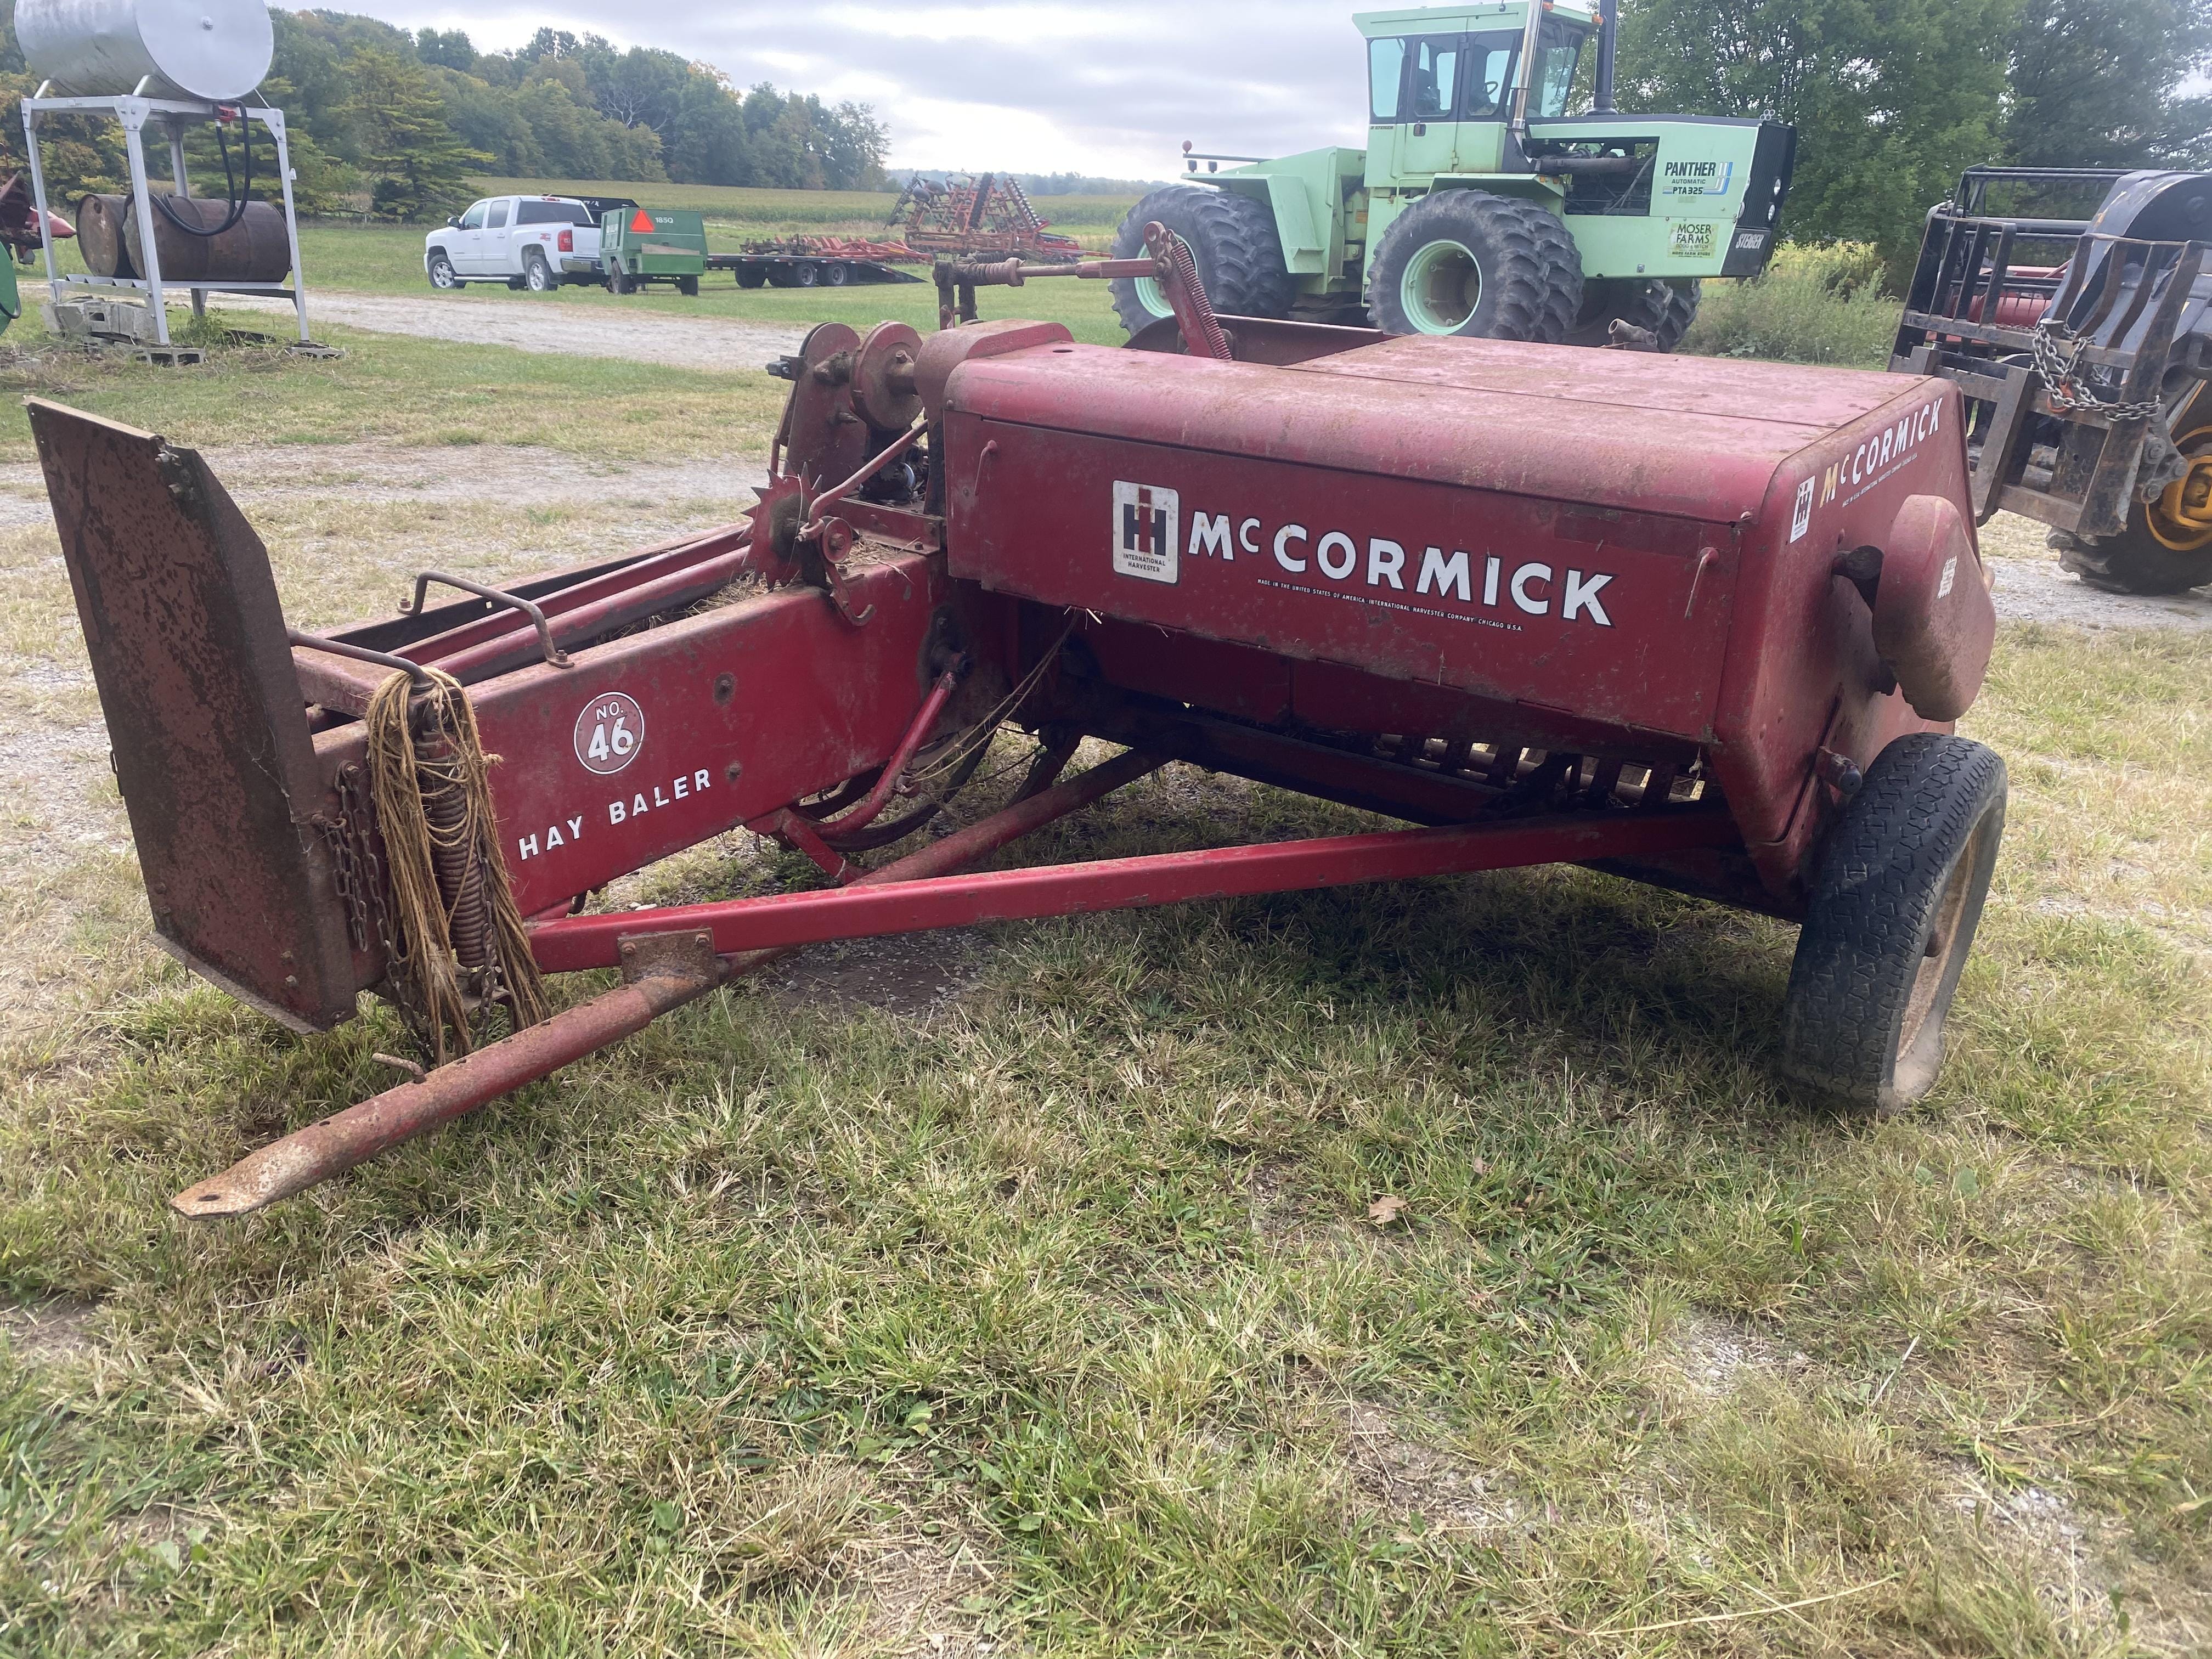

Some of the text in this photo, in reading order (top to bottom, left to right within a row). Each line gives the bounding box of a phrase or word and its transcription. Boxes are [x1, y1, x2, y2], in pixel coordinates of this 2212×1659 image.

[1664, 162, 1716, 176] PANTHER
[1677, 224, 1712, 234] MOSER
[1676, 234, 1710, 244] FARMS
[1123, 553, 1166, 566] INTERNATIONAL
[1128, 561, 1160, 573] HARVESTER
[1292, 585, 1311, 594] UNITED
[1312, 588, 1331, 597] STATES
[1342, 594, 1365, 603] AMERICA
[1368, 599, 1410, 612] INTERNATIONAL
[1413, 606, 1444, 618] HARVESTER
[1447, 612, 1475, 623] COMPANY
[1478, 618, 1504, 629] CHICAGO
[595, 701, 624, 721] NO.
[588, 715, 634, 761] 46
[518, 769, 711, 861] HAY BALER
